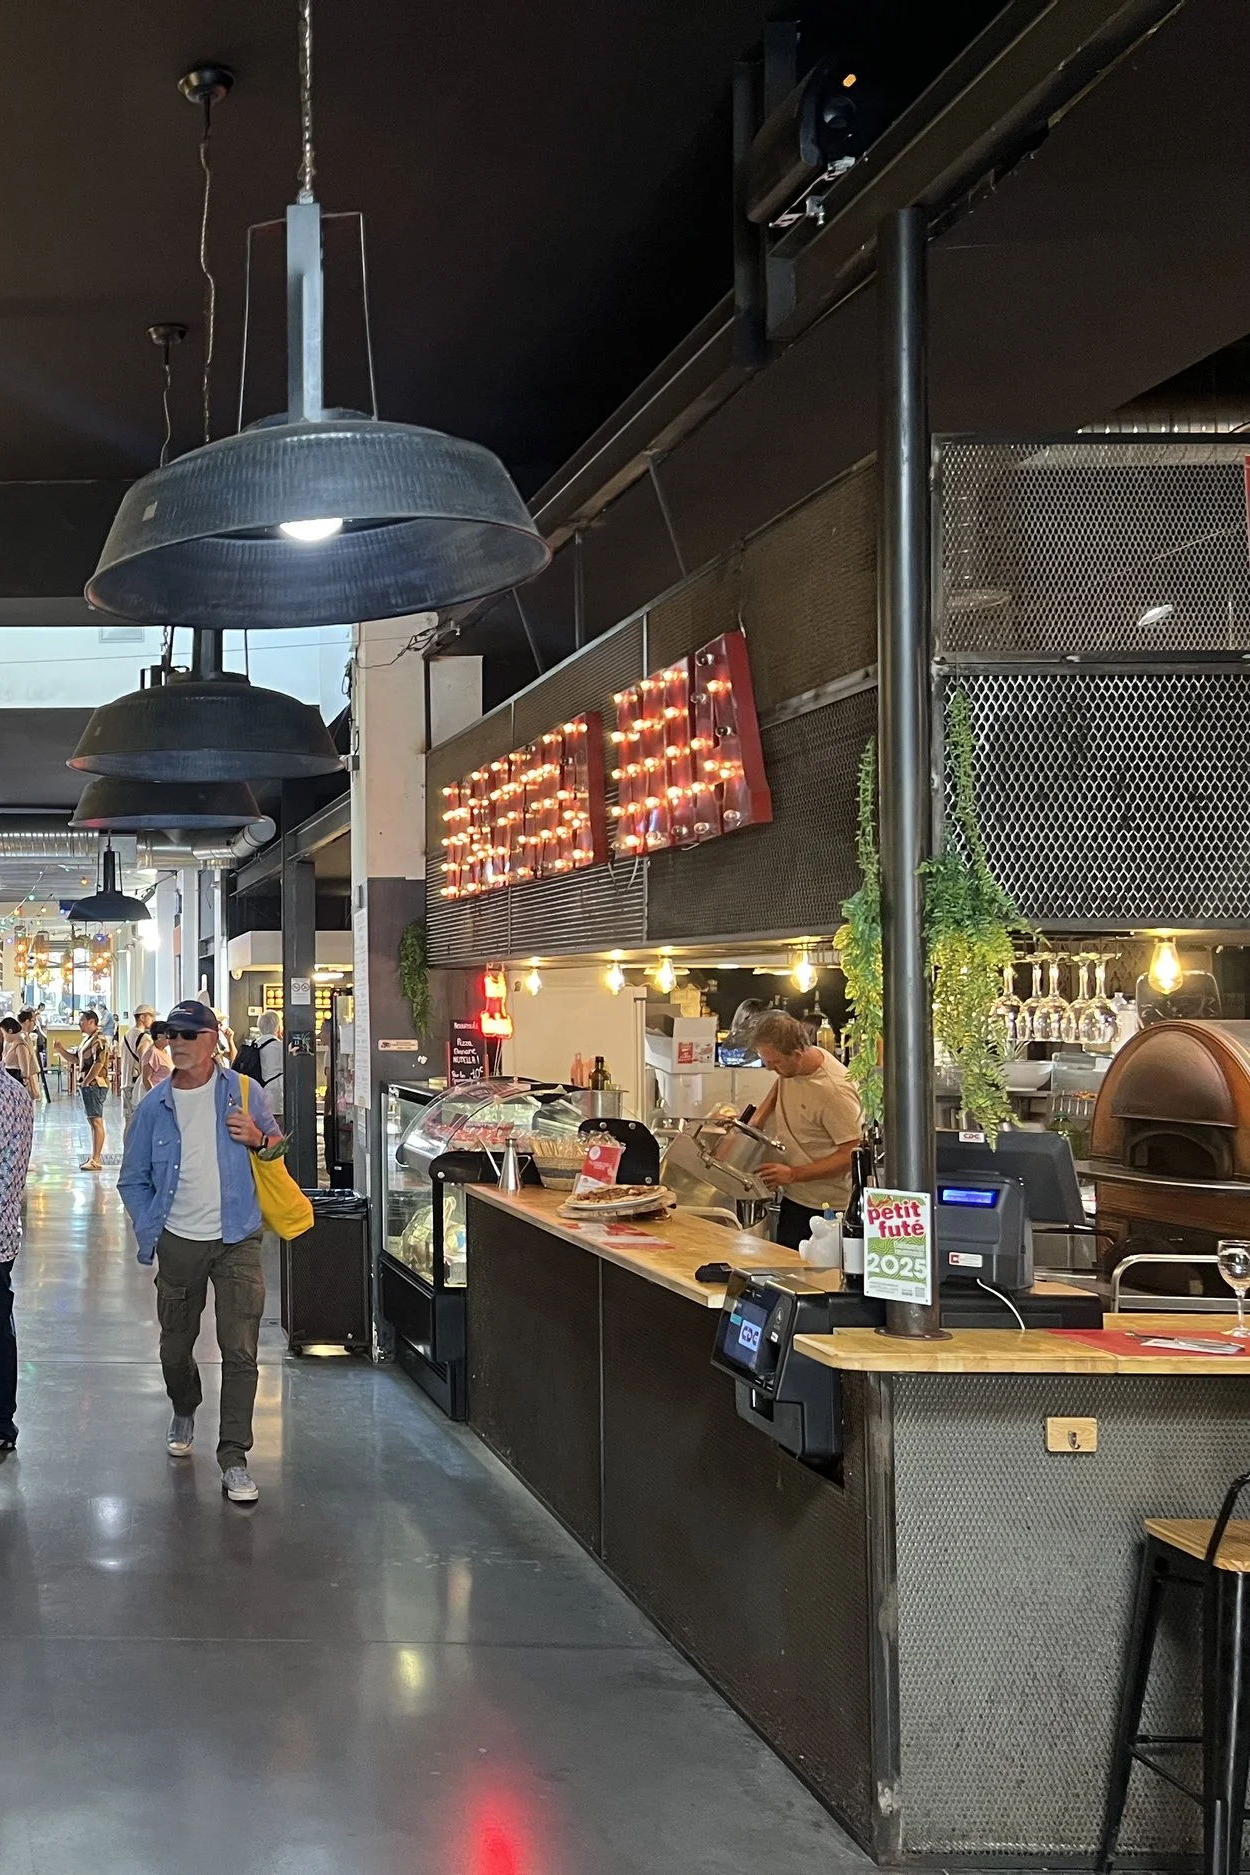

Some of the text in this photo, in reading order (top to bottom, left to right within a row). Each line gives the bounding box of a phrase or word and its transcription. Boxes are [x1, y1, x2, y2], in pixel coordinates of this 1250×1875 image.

[867, 1200, 922, 1225] petit
[878, 1219, 925, 1239] futé
[867, 1252, 927, 1279] 2025
